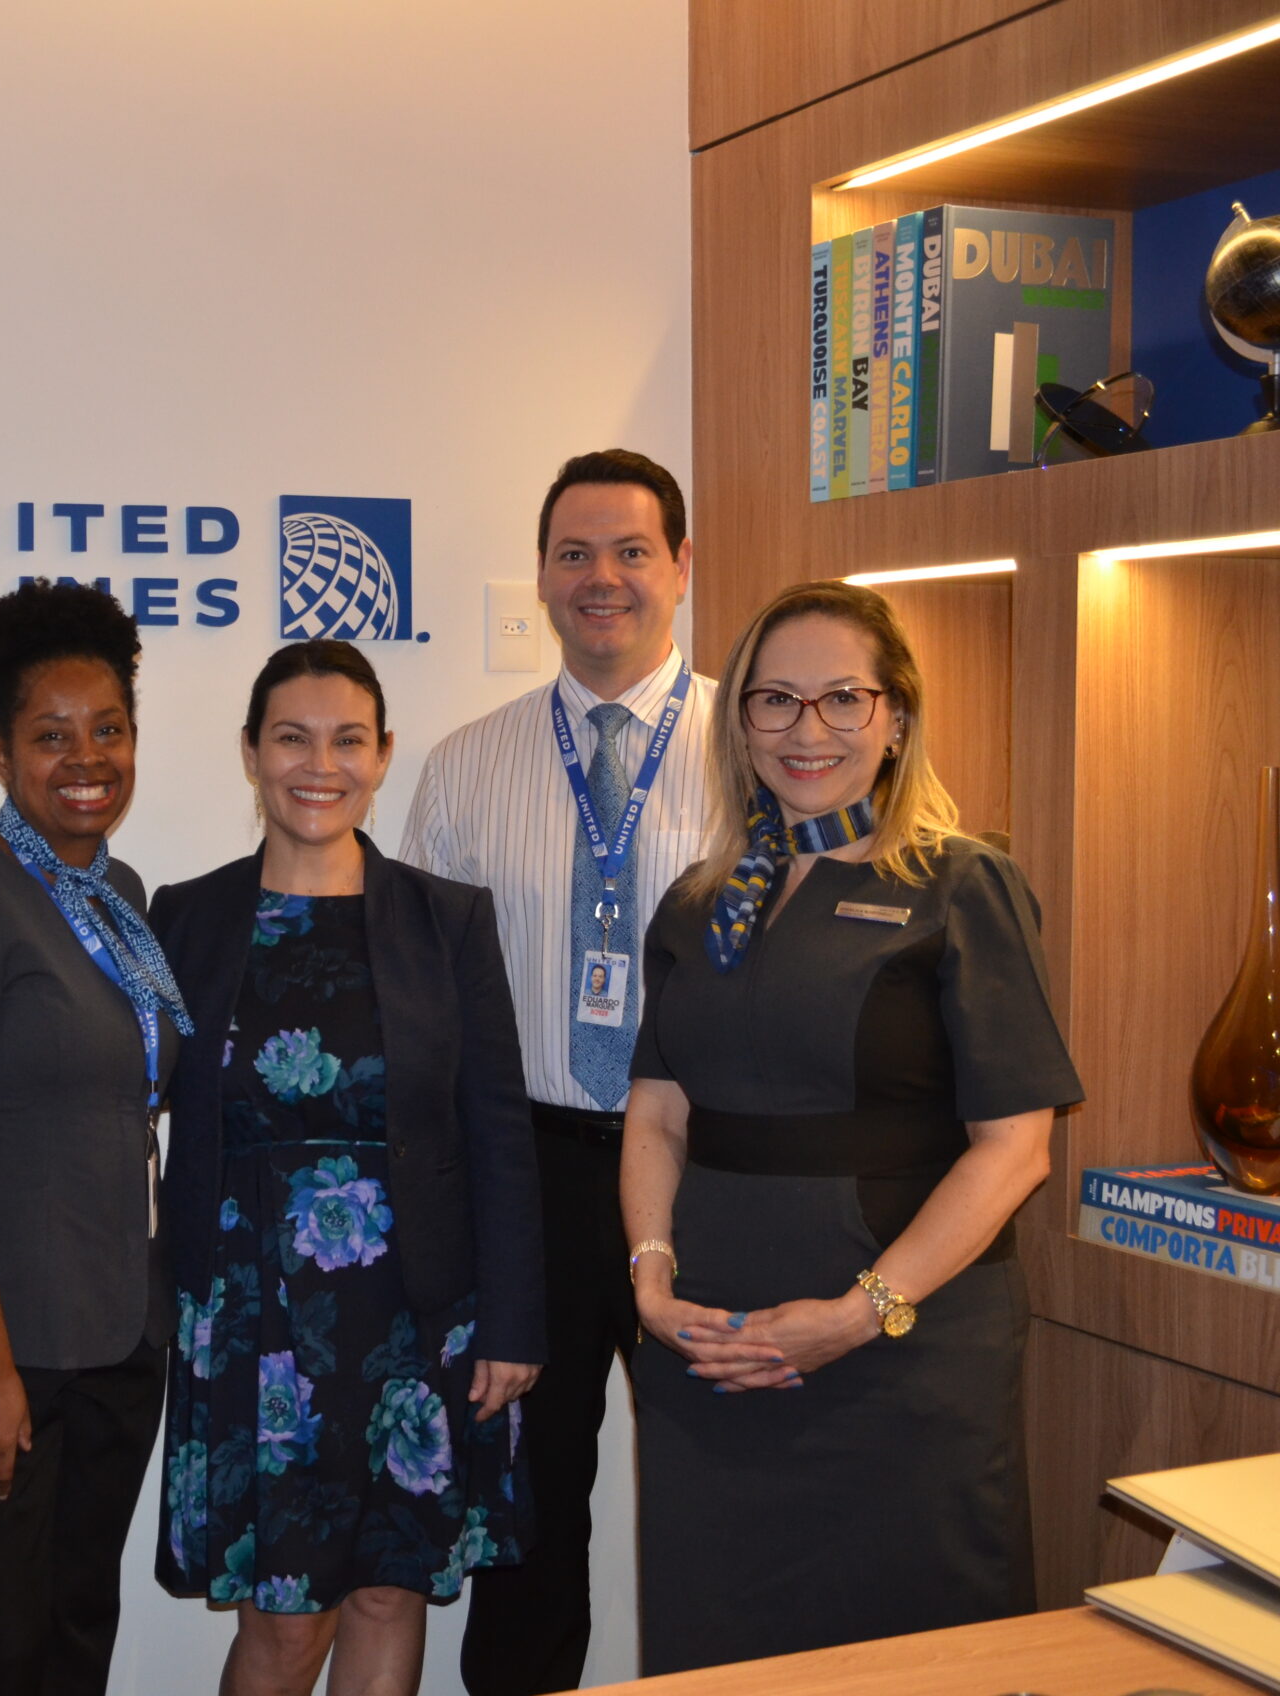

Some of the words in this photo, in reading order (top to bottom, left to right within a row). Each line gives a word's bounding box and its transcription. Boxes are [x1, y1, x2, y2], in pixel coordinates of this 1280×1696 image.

[892, 241, 915, 358] MONTE
[921, 234, 942, 333] DUBAI
[952, 227, 1108, 289] DUBAI
[813, 264, 828, 399] TURQUOISE
[833, 258, 849, 374] TUSCANY
[852, 254, 871, 358] BYRON
[872, 250, 890, 359] ATHENS
[833, 375, 848, 478] MARVEL
[851, 356, 869, 411] BAY
[870, 359, 888, 473] RIVIERA
[889, 360, 912, 467] CARLO
[812, 401, 827, 480] COAST
[554, 708, 571, 751] UNITED
[650, 711, 675, 758] UNITED
[578, 793, 600, 842] UNITED
[614, 804, 639, 855] UNITED
[1100, 1215, 1236, 1275] COMPORTA
[1101, 1182, 1216, 1230] HAMPTONS
